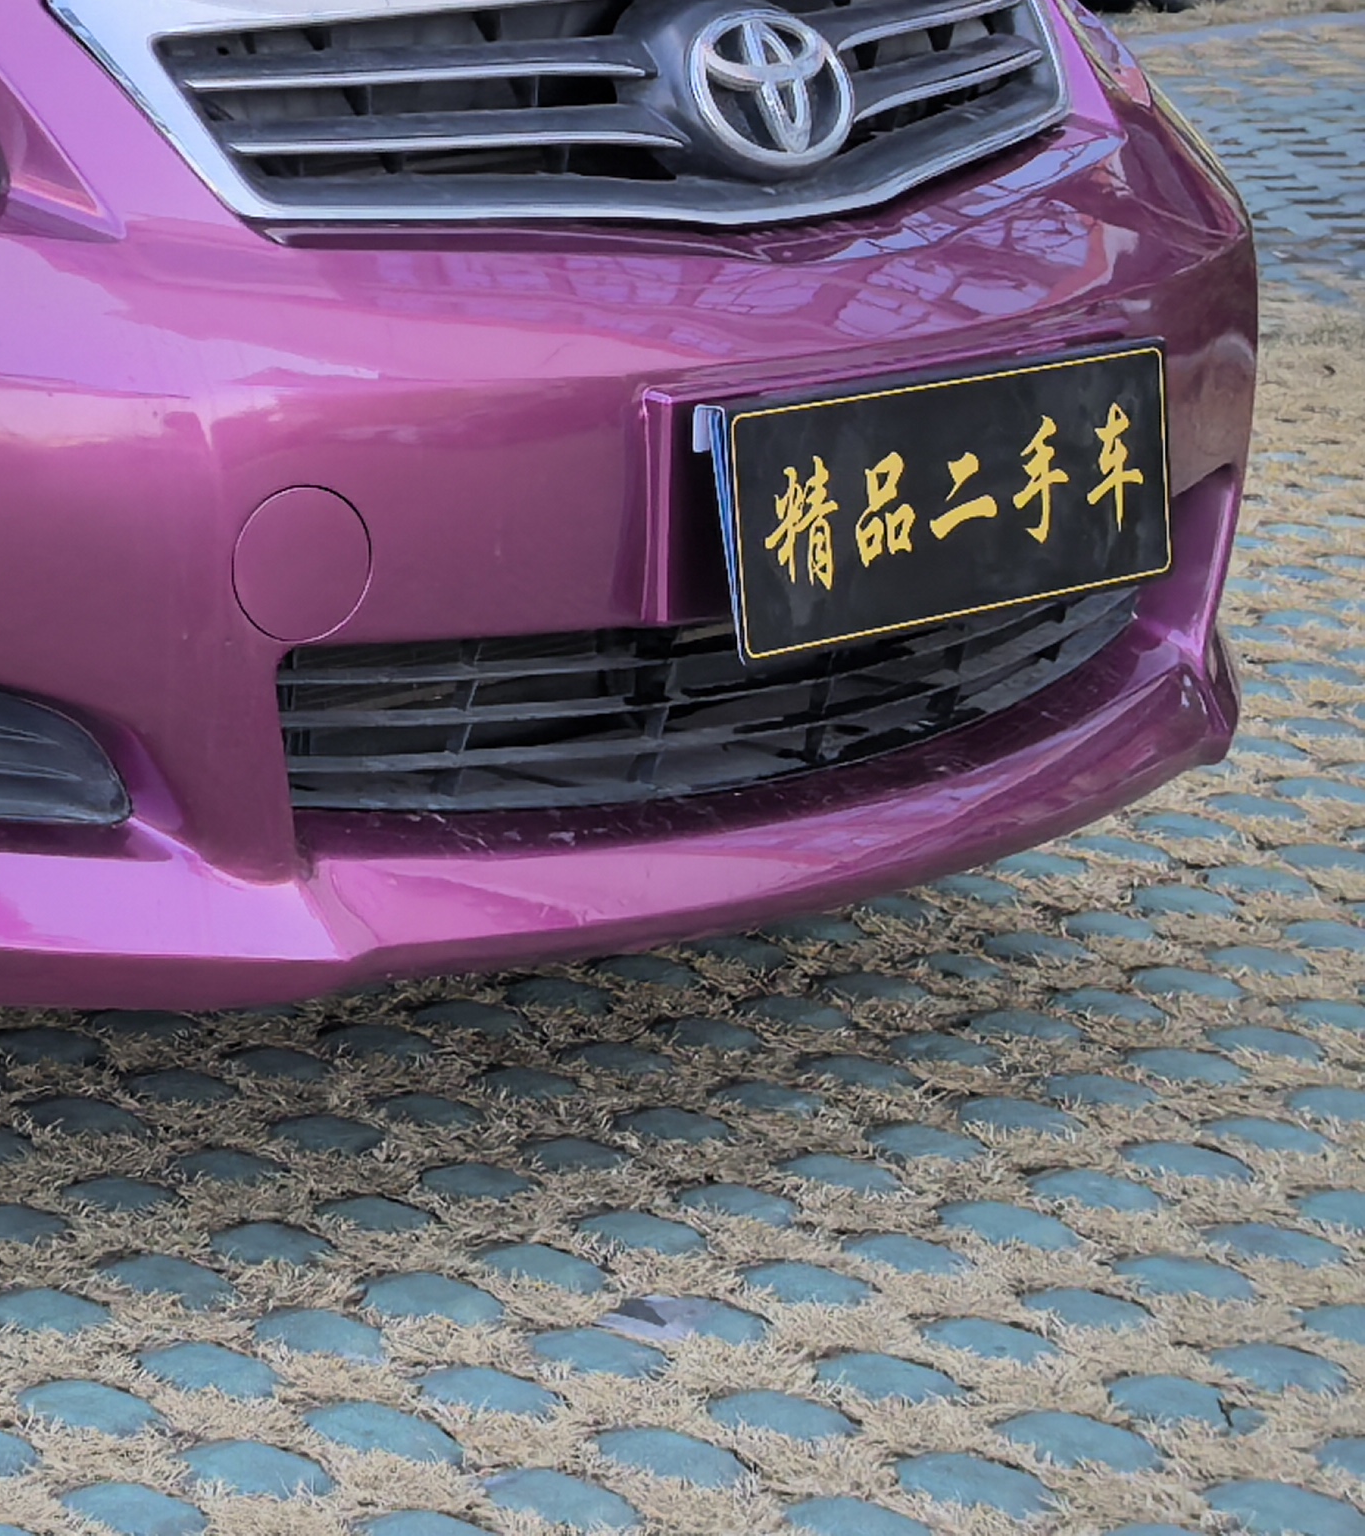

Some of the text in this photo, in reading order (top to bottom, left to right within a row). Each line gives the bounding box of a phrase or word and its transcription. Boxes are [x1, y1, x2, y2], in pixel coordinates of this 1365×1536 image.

[764, 401, 1144, 591] 精品二手车
